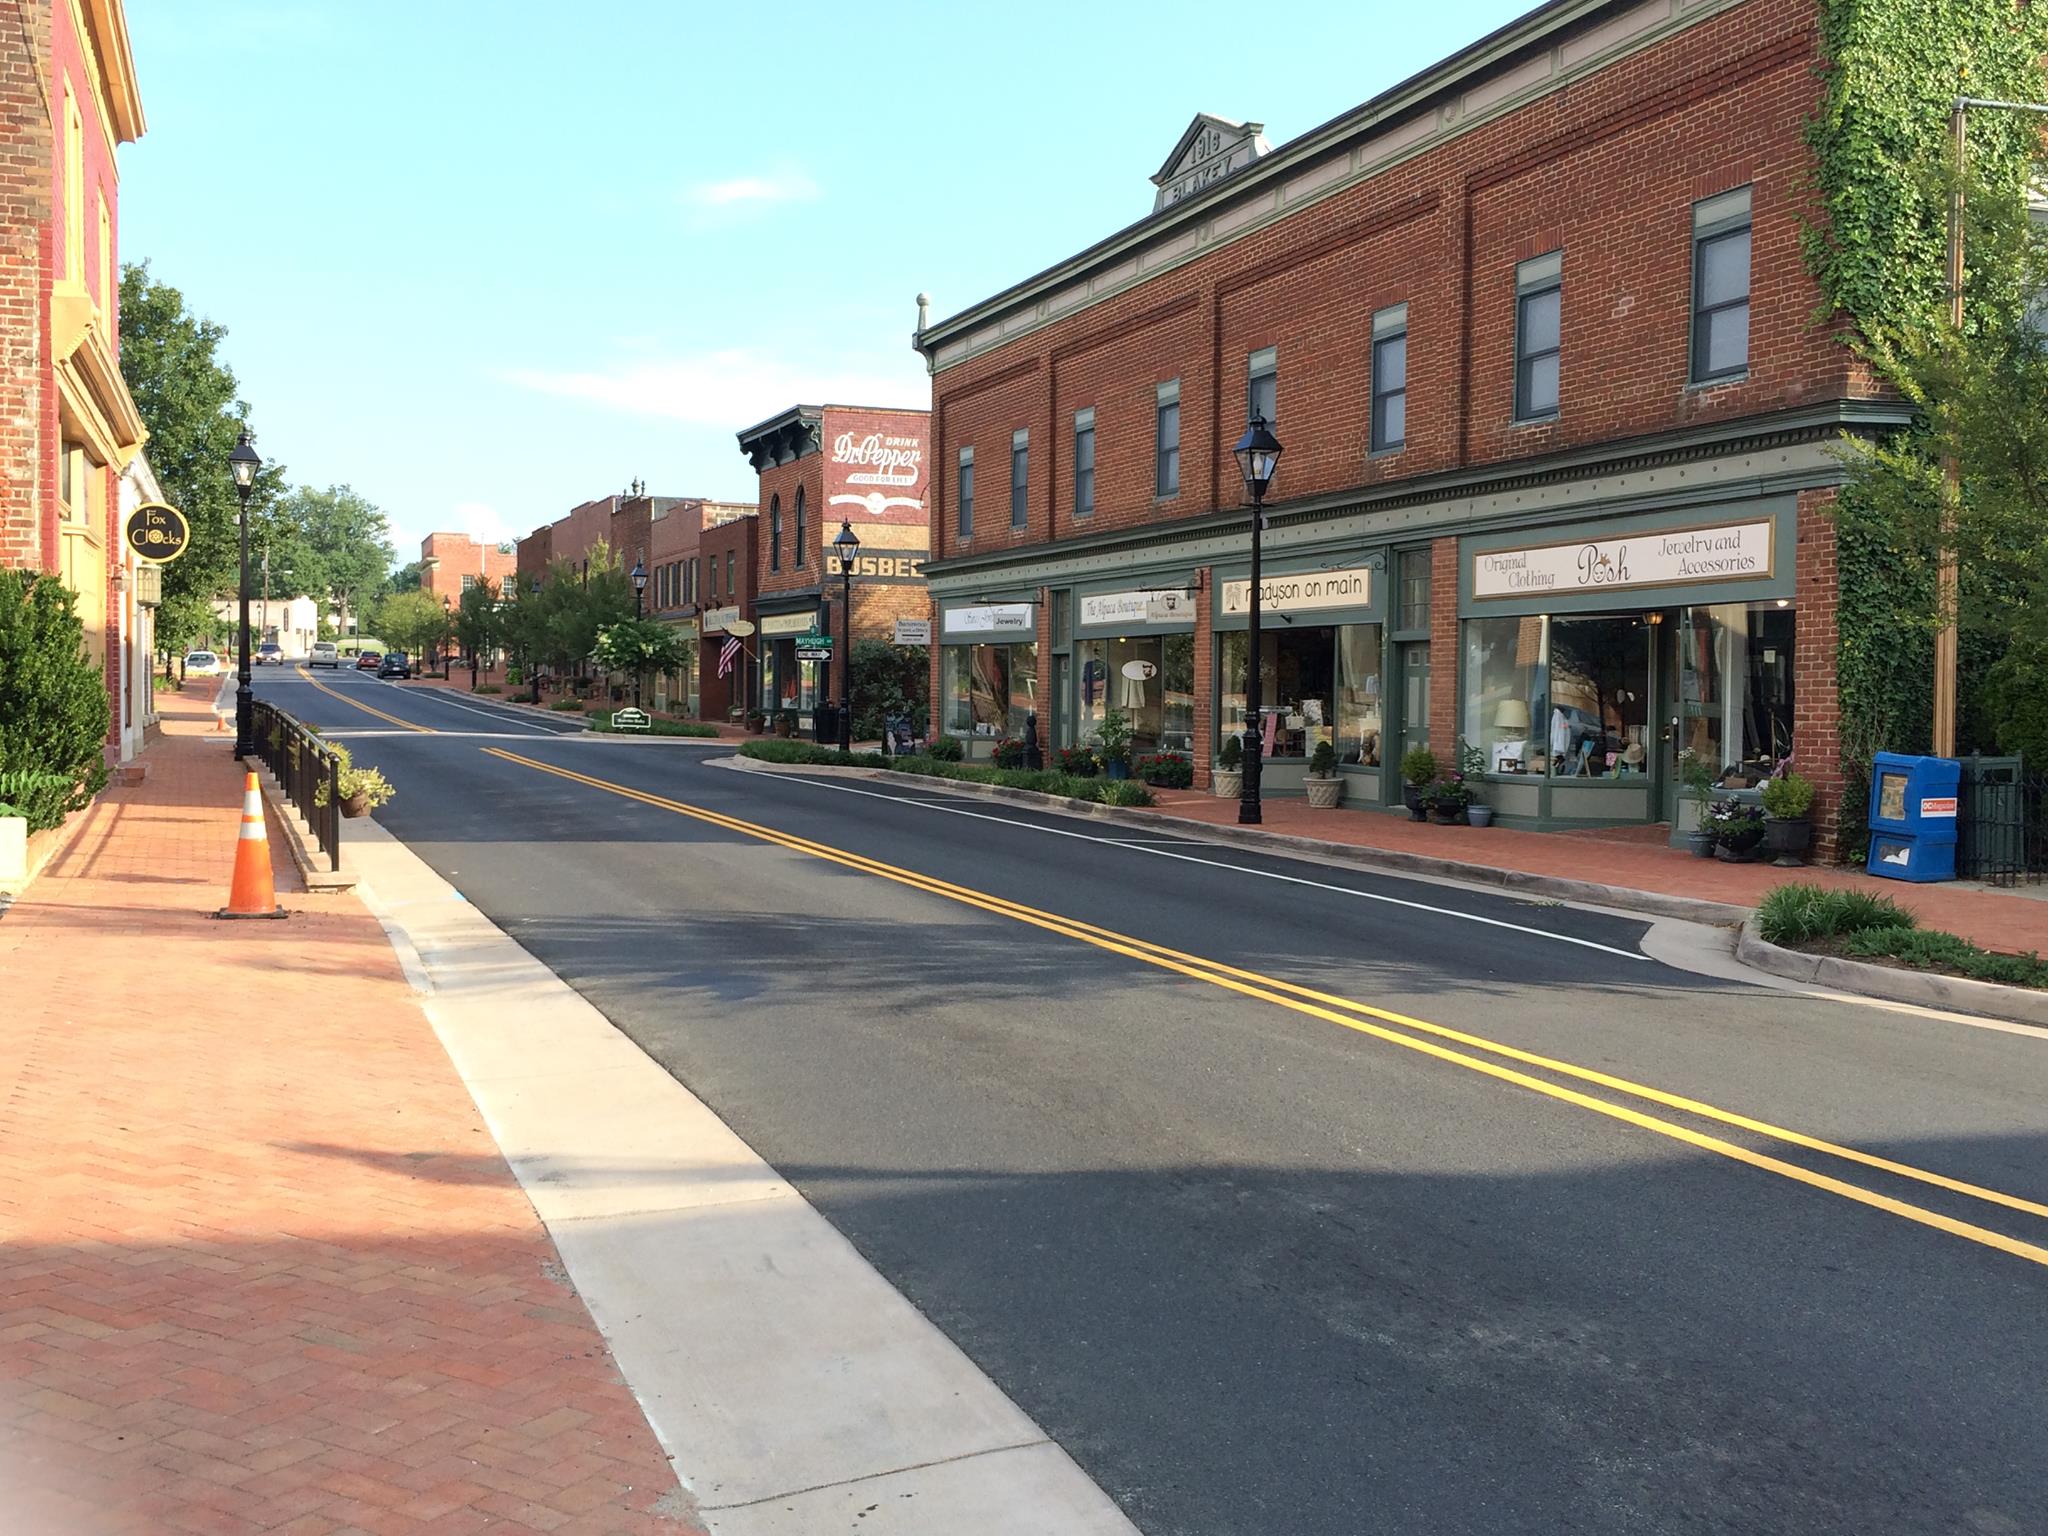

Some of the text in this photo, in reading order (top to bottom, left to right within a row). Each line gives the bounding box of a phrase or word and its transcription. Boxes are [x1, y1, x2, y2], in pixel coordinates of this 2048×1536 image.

[886, 437, 919, 447] DRINK
[858, 433, 921, 475] Pepper
[146, 510, 166, 526] Fox
[132, 528, 182, 545] Clocks
[1658, 530, 1741, 557] Jewelry and
[1484, 552, 1527, 573] Original
[1577, 544, 1631, 585] Posh
[1678, 555, 1755, 576] Accessories
[1304, 582, 1322, 597] on
[1326, 574, 1362, 596] main
[1508, 571, 1555, 588] Clothing
[996, 617, 1023, 626] Jewelry
